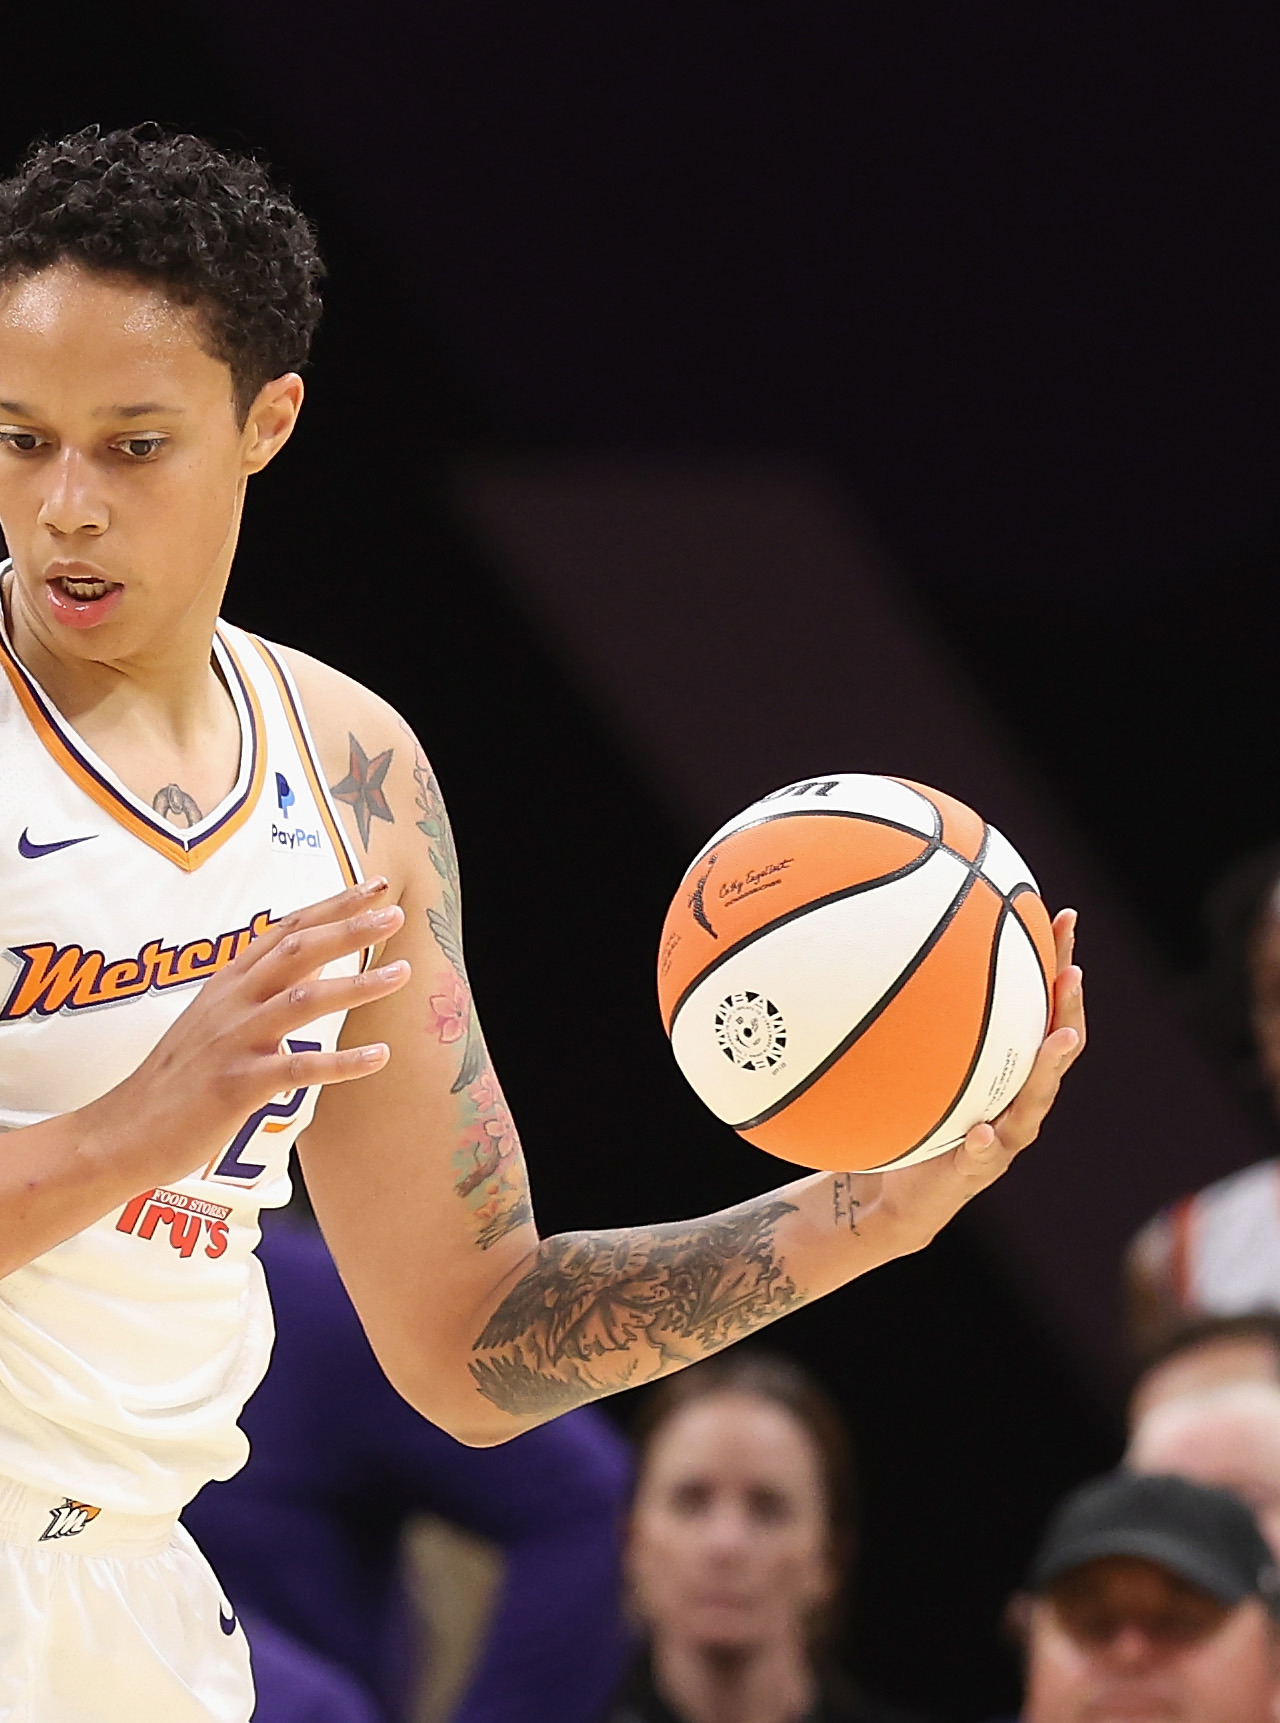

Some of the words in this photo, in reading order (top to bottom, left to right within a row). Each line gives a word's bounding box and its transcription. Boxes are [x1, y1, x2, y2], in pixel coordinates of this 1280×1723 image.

[271, 823, 321, 849] PayPal
[150, 1188, 189, 1208] FOOD
[188, 1199, 229, 1219] STORES
